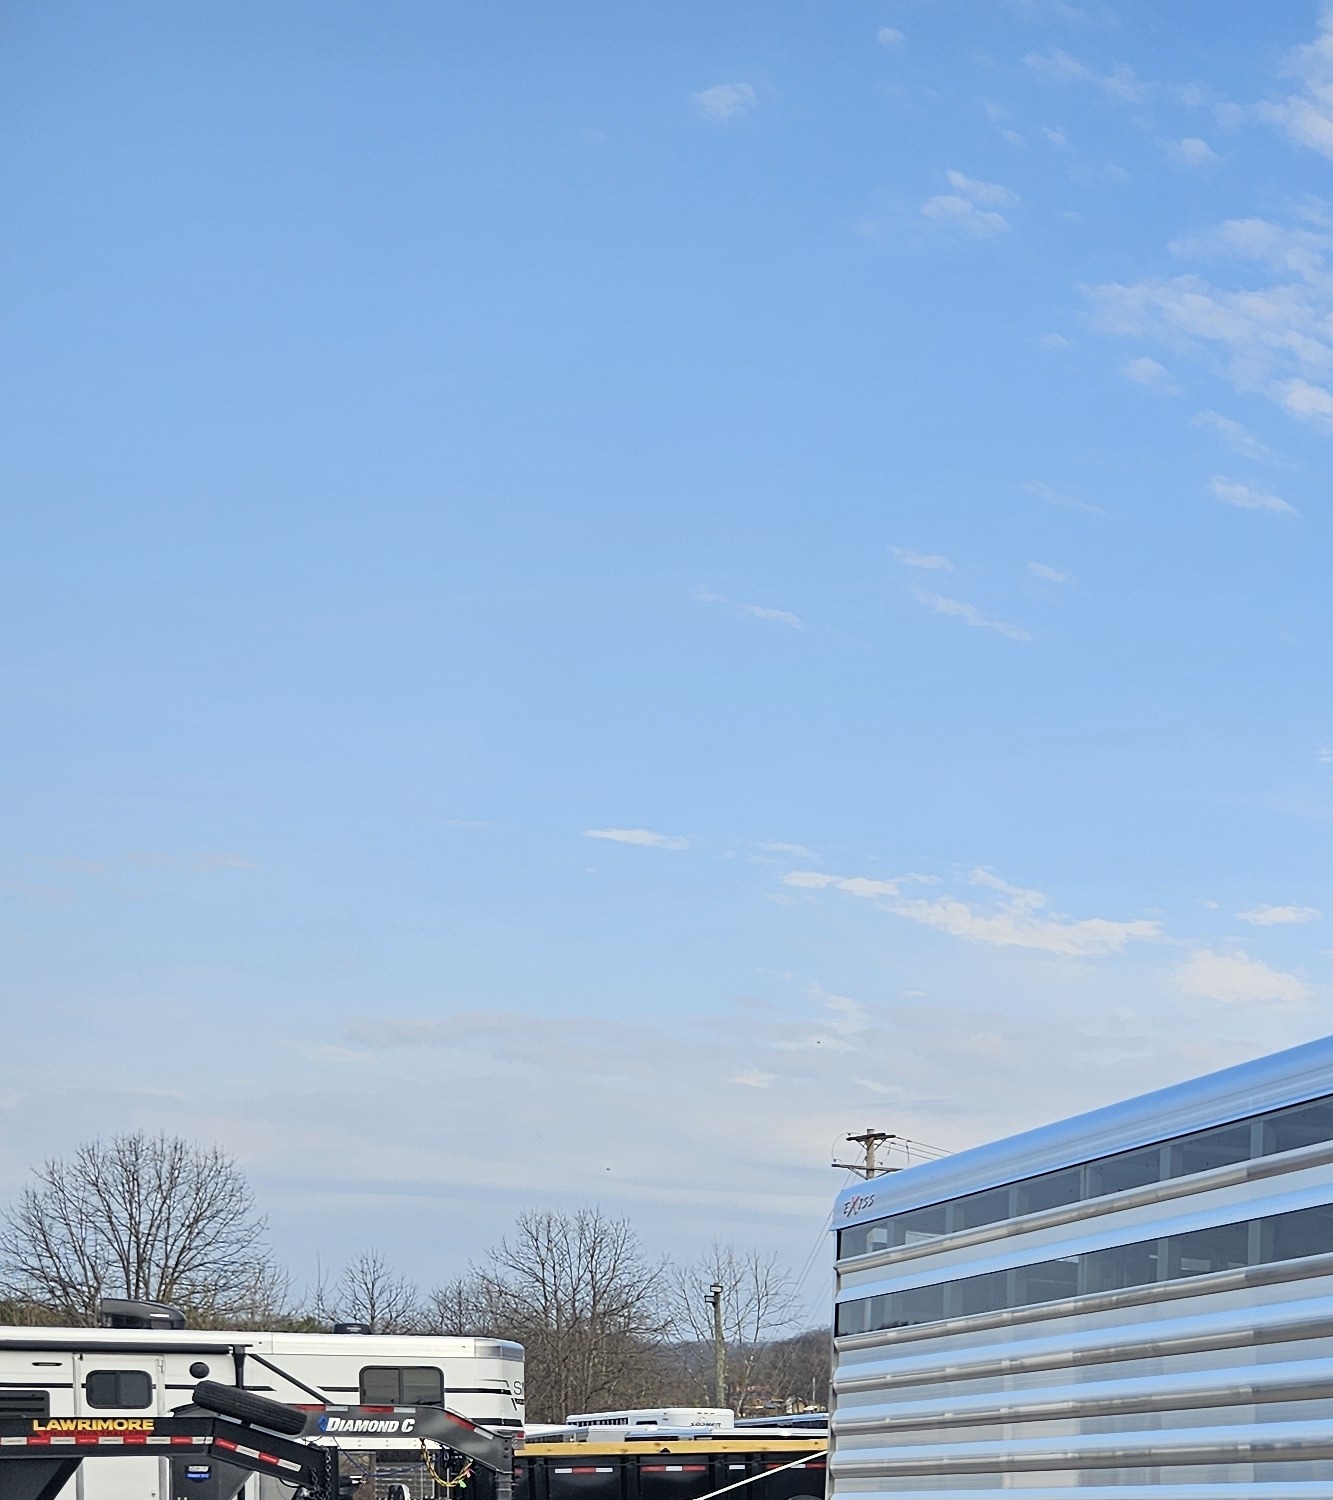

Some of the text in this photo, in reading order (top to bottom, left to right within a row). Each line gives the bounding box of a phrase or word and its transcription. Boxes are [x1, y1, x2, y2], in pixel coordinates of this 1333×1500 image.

[843, 1194, 875, 1217] EXISS
[33, 1419, 155, 1431] LAWRIMORE
[326, 1417, 415, 1433] DIAMOND C
